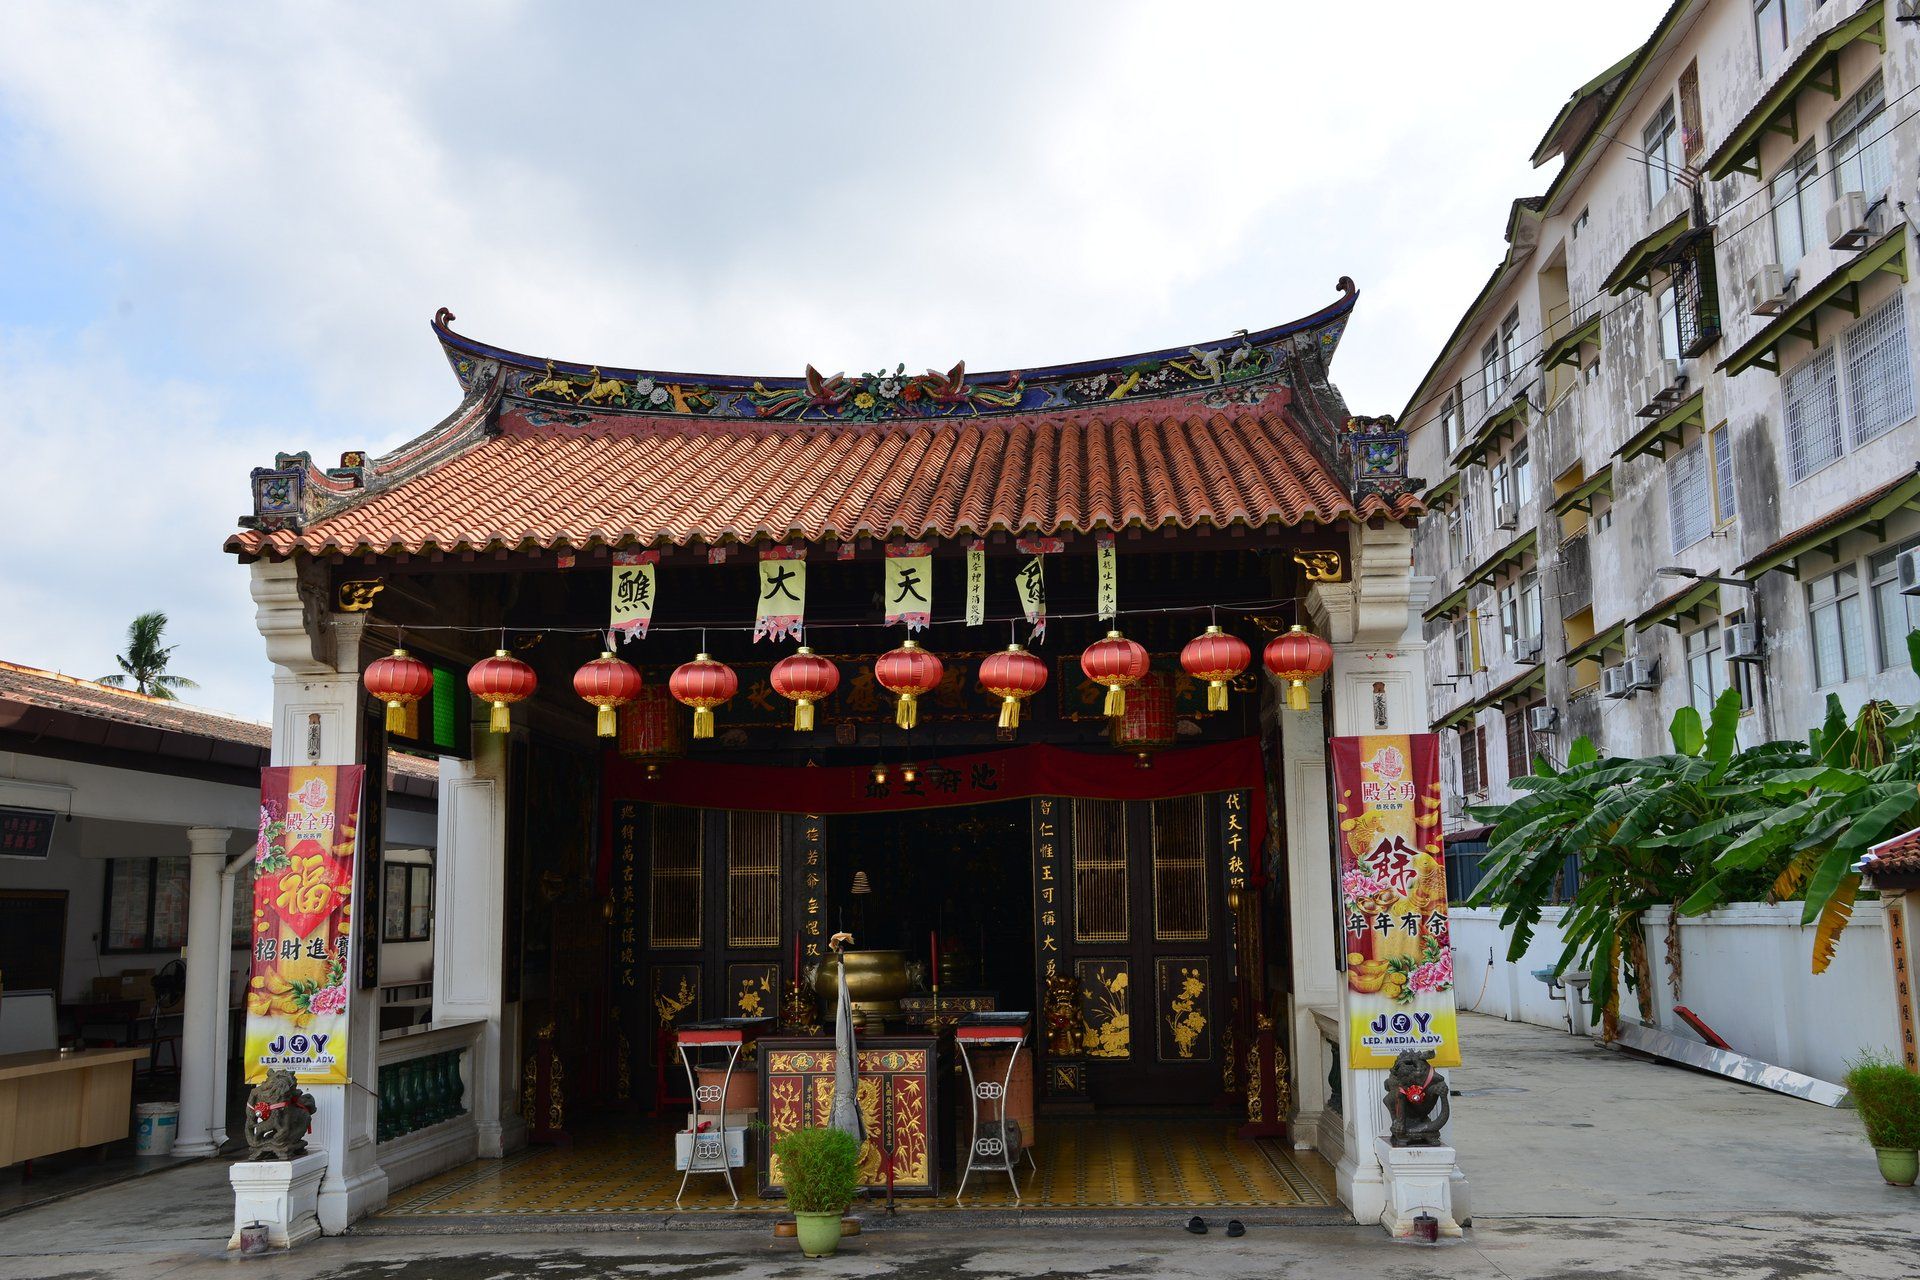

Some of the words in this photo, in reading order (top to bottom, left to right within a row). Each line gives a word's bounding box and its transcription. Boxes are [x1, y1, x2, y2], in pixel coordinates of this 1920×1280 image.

[614, 570, 650, 613] 醮
[766, 565, 801, 603] 大
[893, 568, 927, 605] 天
[275, 853, 332, 916] 福
[1346, 912, 1449, 938] 年年有余
[254, 936, 350, 962] 招財進寶
[1371, 1012, 1431, 1034] JOY
[269, 1033, 329, 1055] JOY
[1363, 1037, 1383, 1045] LED.
[1385, 1036, 1419, 1044] MEDIA.
[1420, 1035, 1442, 1043] ADV.
